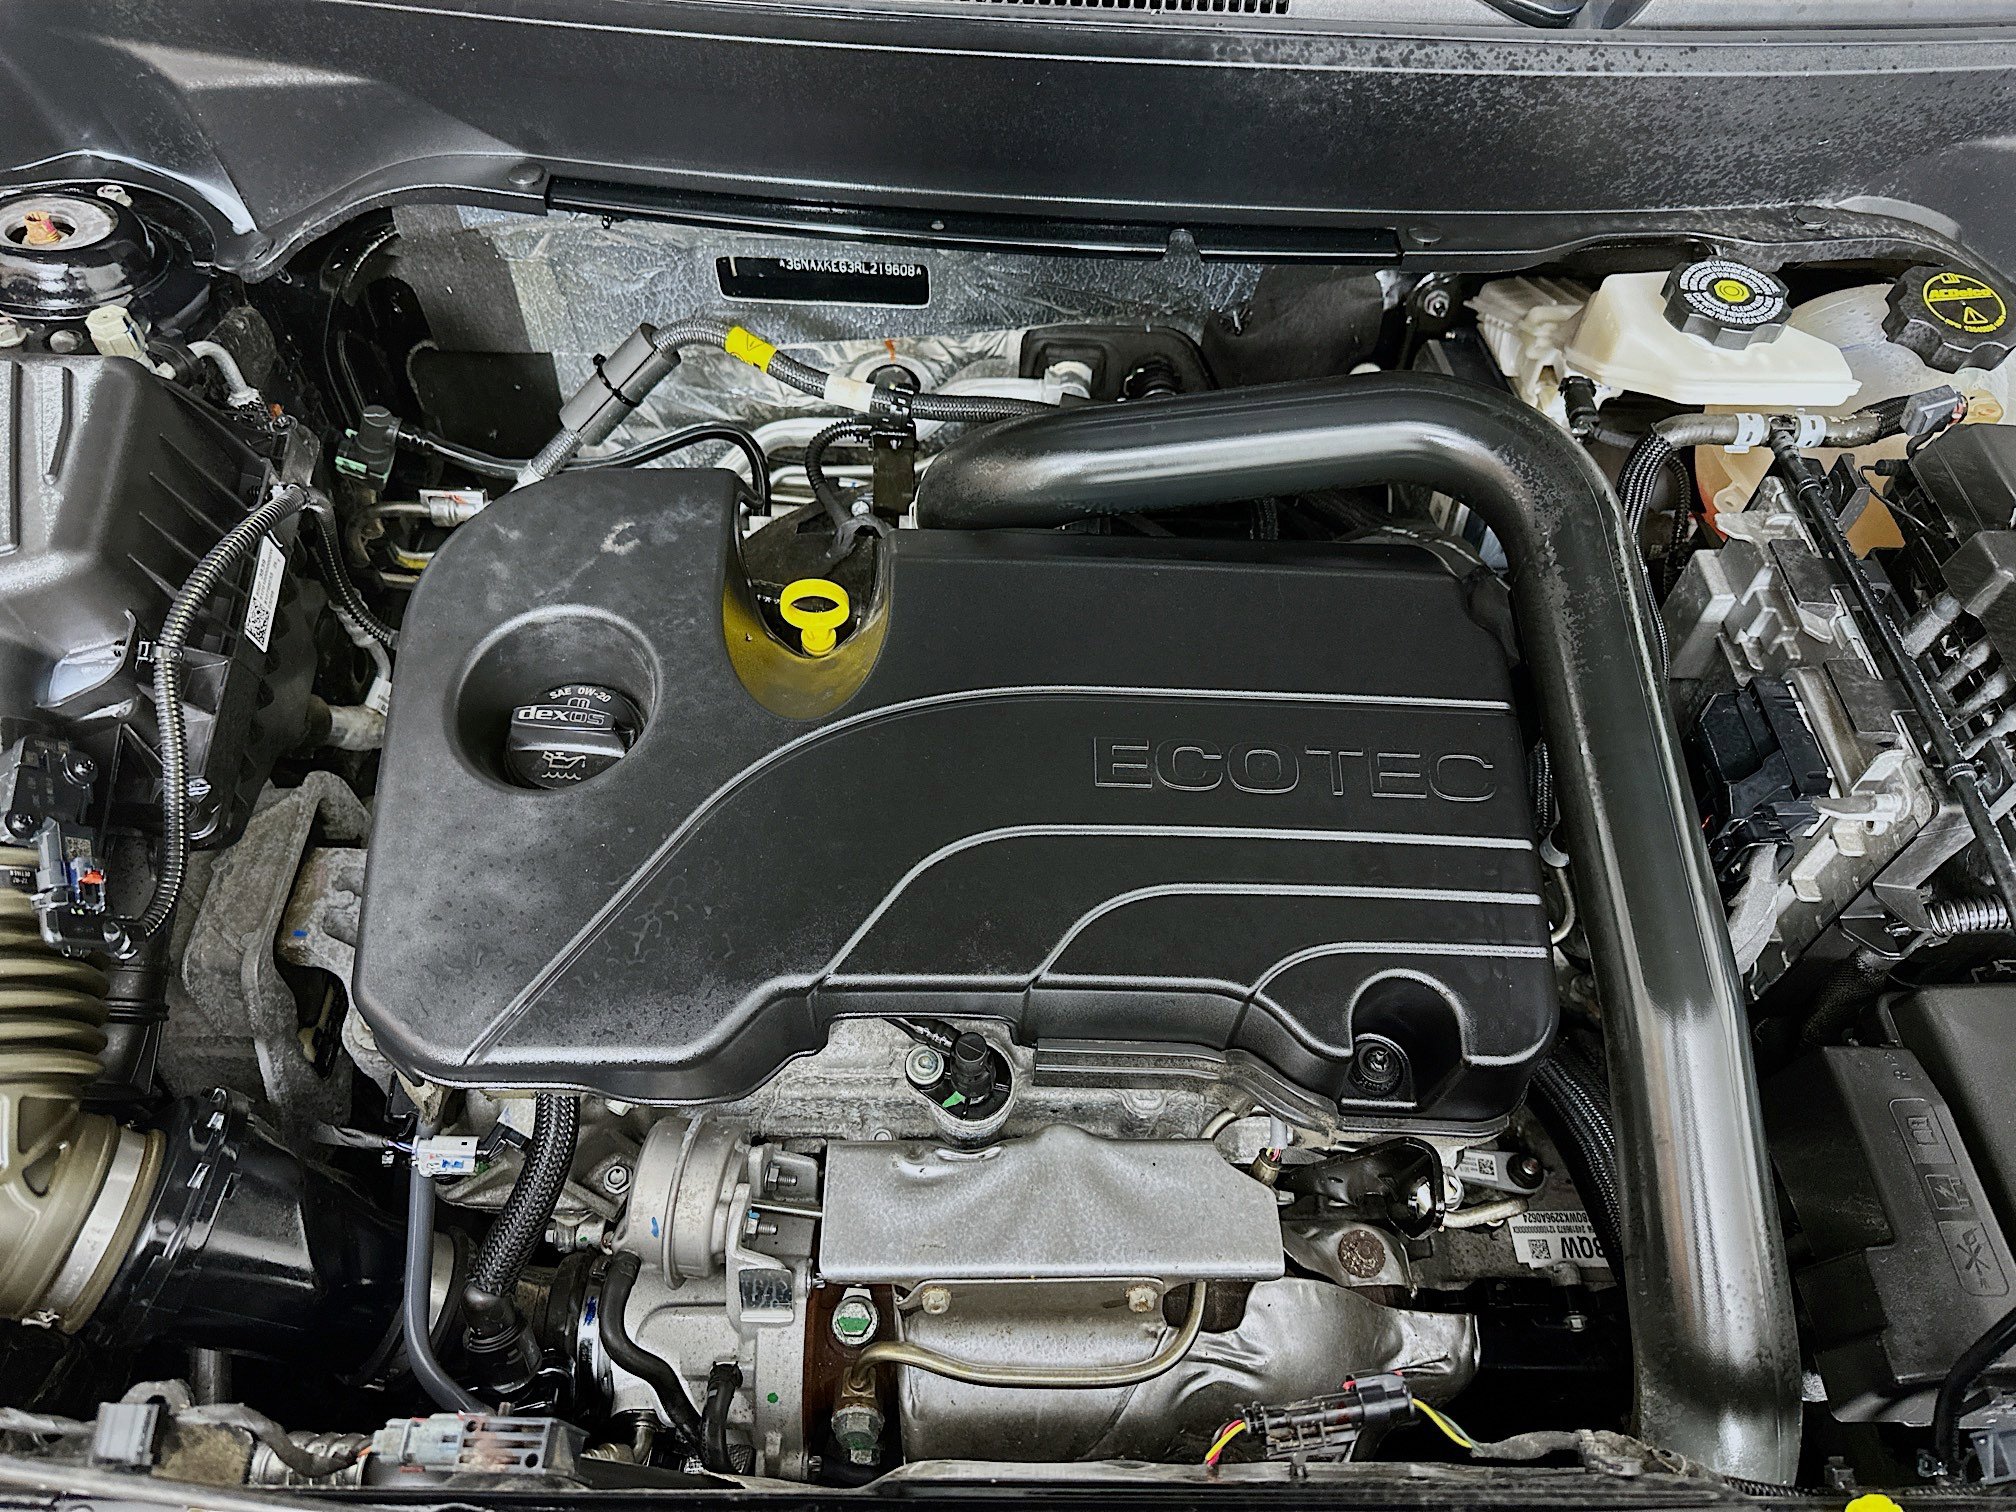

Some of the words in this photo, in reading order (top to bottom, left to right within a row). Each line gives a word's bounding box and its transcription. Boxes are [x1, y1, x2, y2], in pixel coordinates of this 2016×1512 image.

[1928, 288, 1993, 298] ACDelco
[550, 687, 572, 700] SAE
[577, 687, 612, 703] 0W-20
[518, 705, 605, 726] dexos
[1093, 735, 1497, 803] ECOTEC
